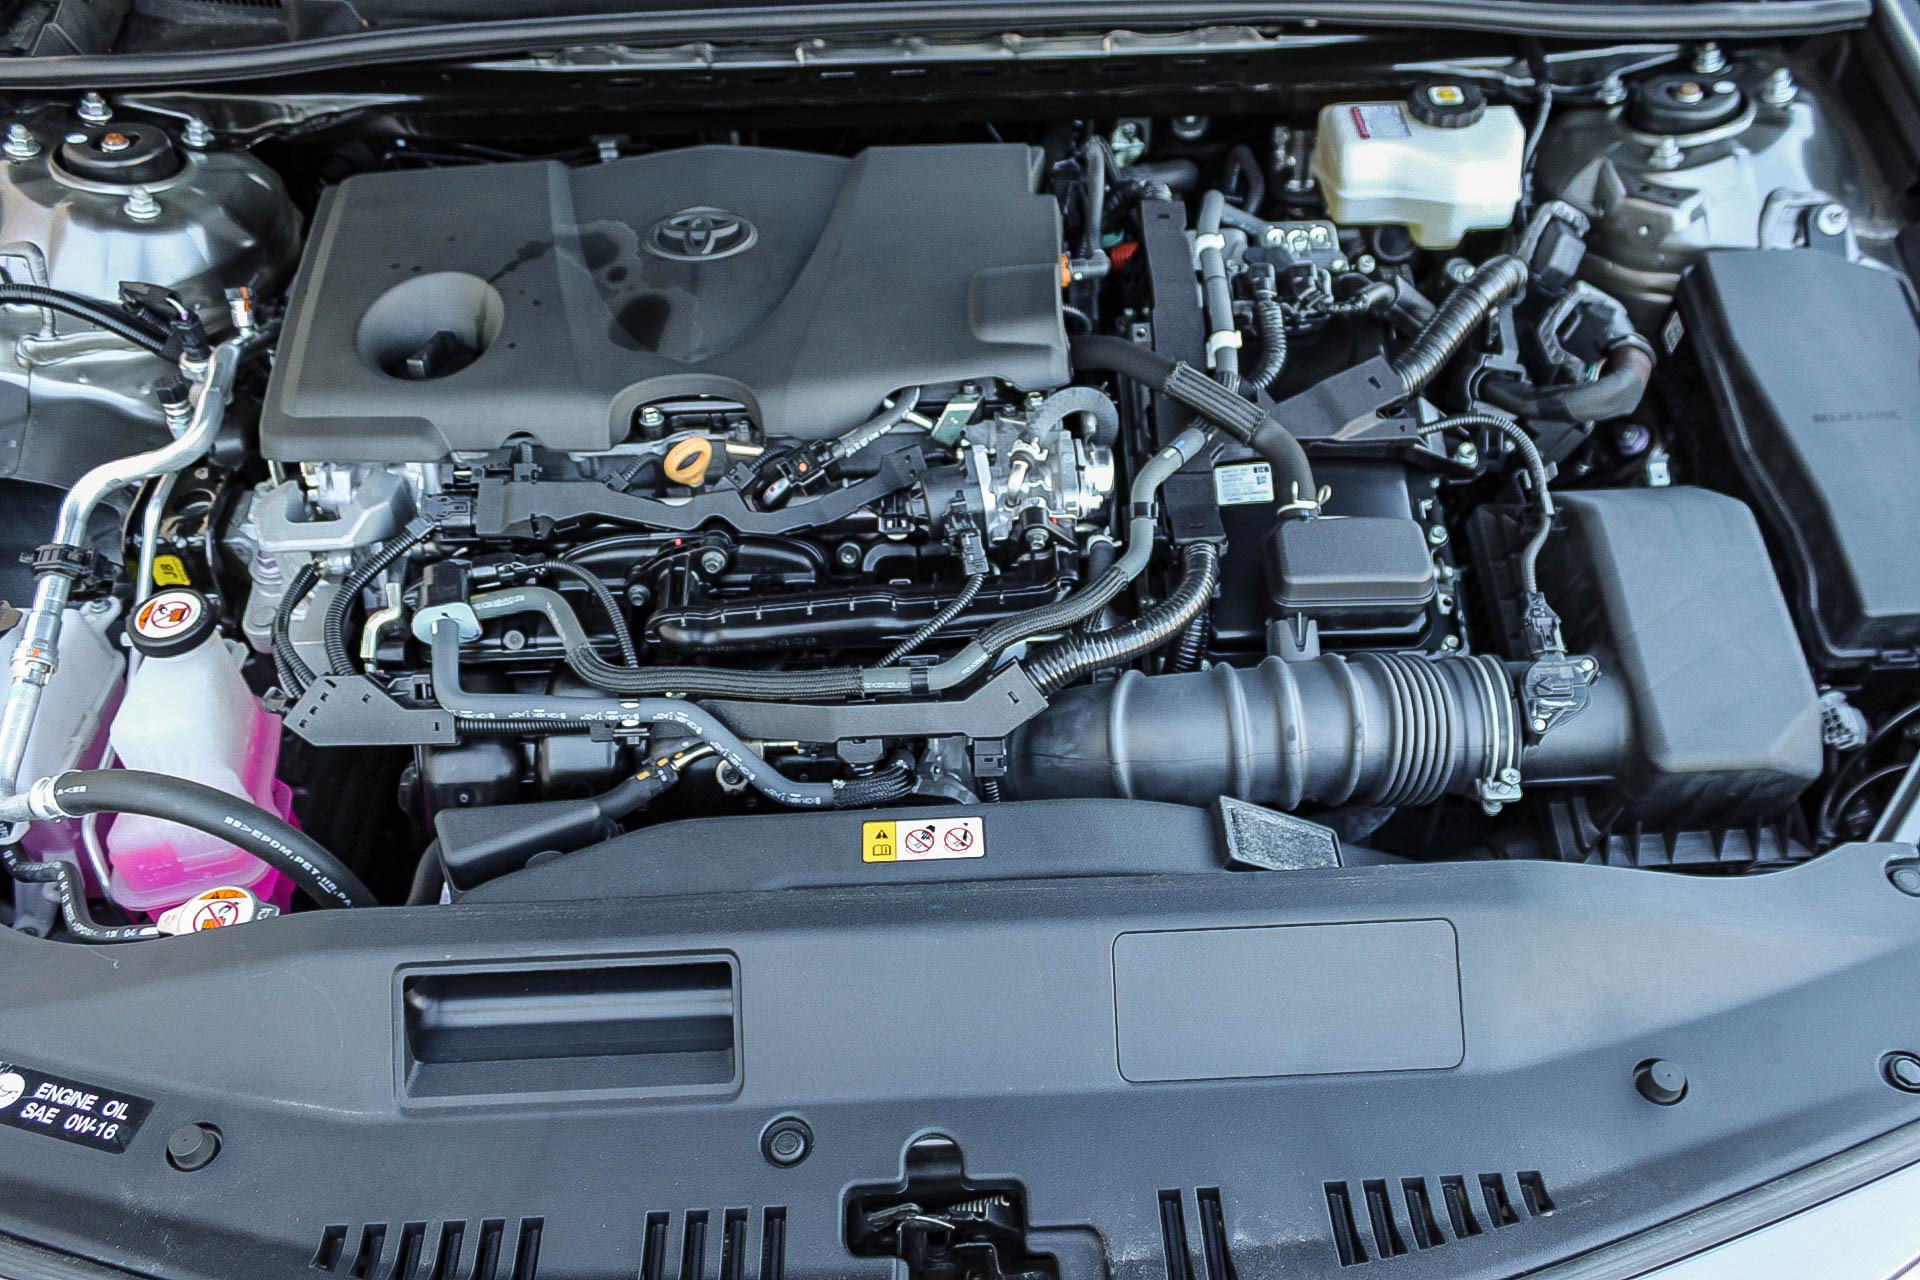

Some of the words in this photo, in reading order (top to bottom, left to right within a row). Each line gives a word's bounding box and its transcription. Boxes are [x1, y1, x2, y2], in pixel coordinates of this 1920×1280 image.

[34, 1082, 99, 1111] ENGINE
[102, 1100, 129, 1120] OIL
[20, 1102, 60, 1125] SAE
[63, 1113, 119, 1140] 0W-16
